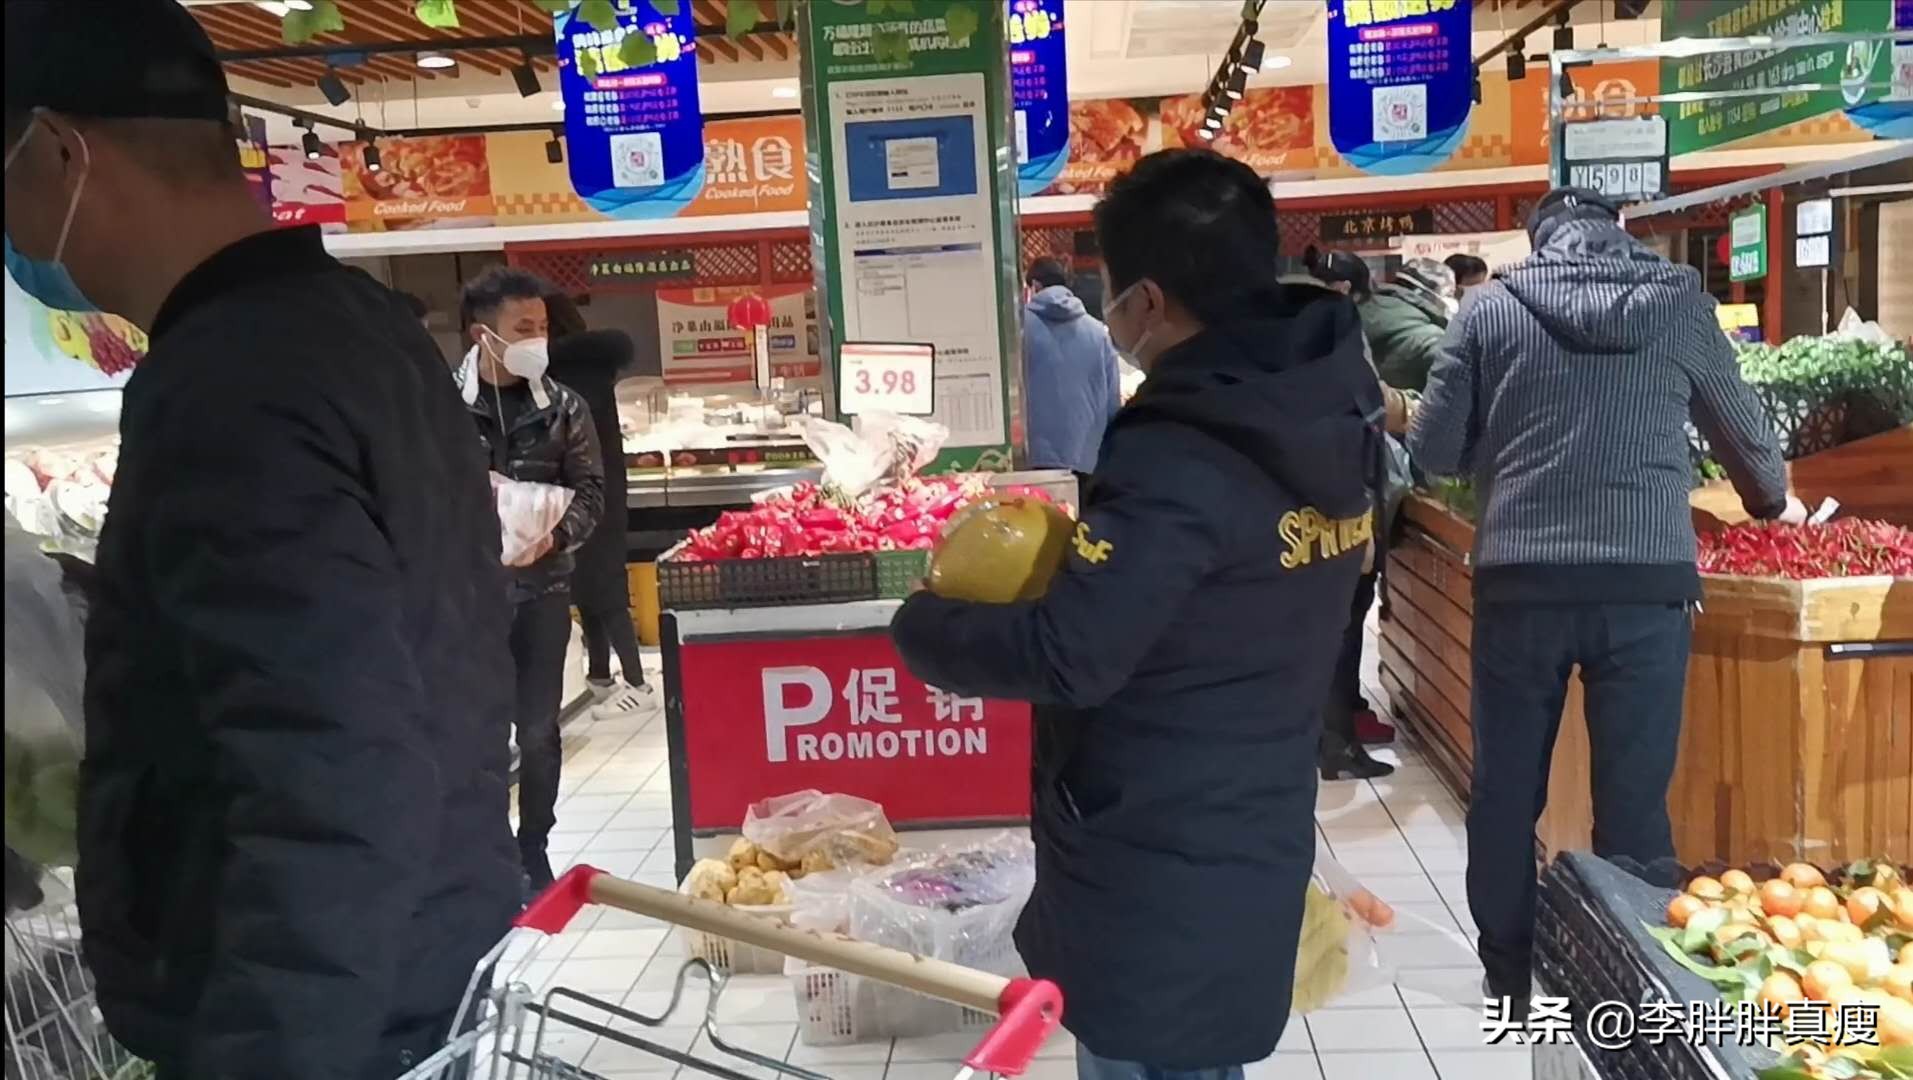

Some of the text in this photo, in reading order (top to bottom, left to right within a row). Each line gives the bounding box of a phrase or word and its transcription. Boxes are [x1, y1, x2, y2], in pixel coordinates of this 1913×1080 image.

[704, 136, 794, 184] 熟食
[705, 184, 794, 201] Cooked Food
[374, 199, 466, 215] Cooked Food
[1343, 215, 1414, 234] 北京烤鸭
[855, 369, 916, 394] 3.98
